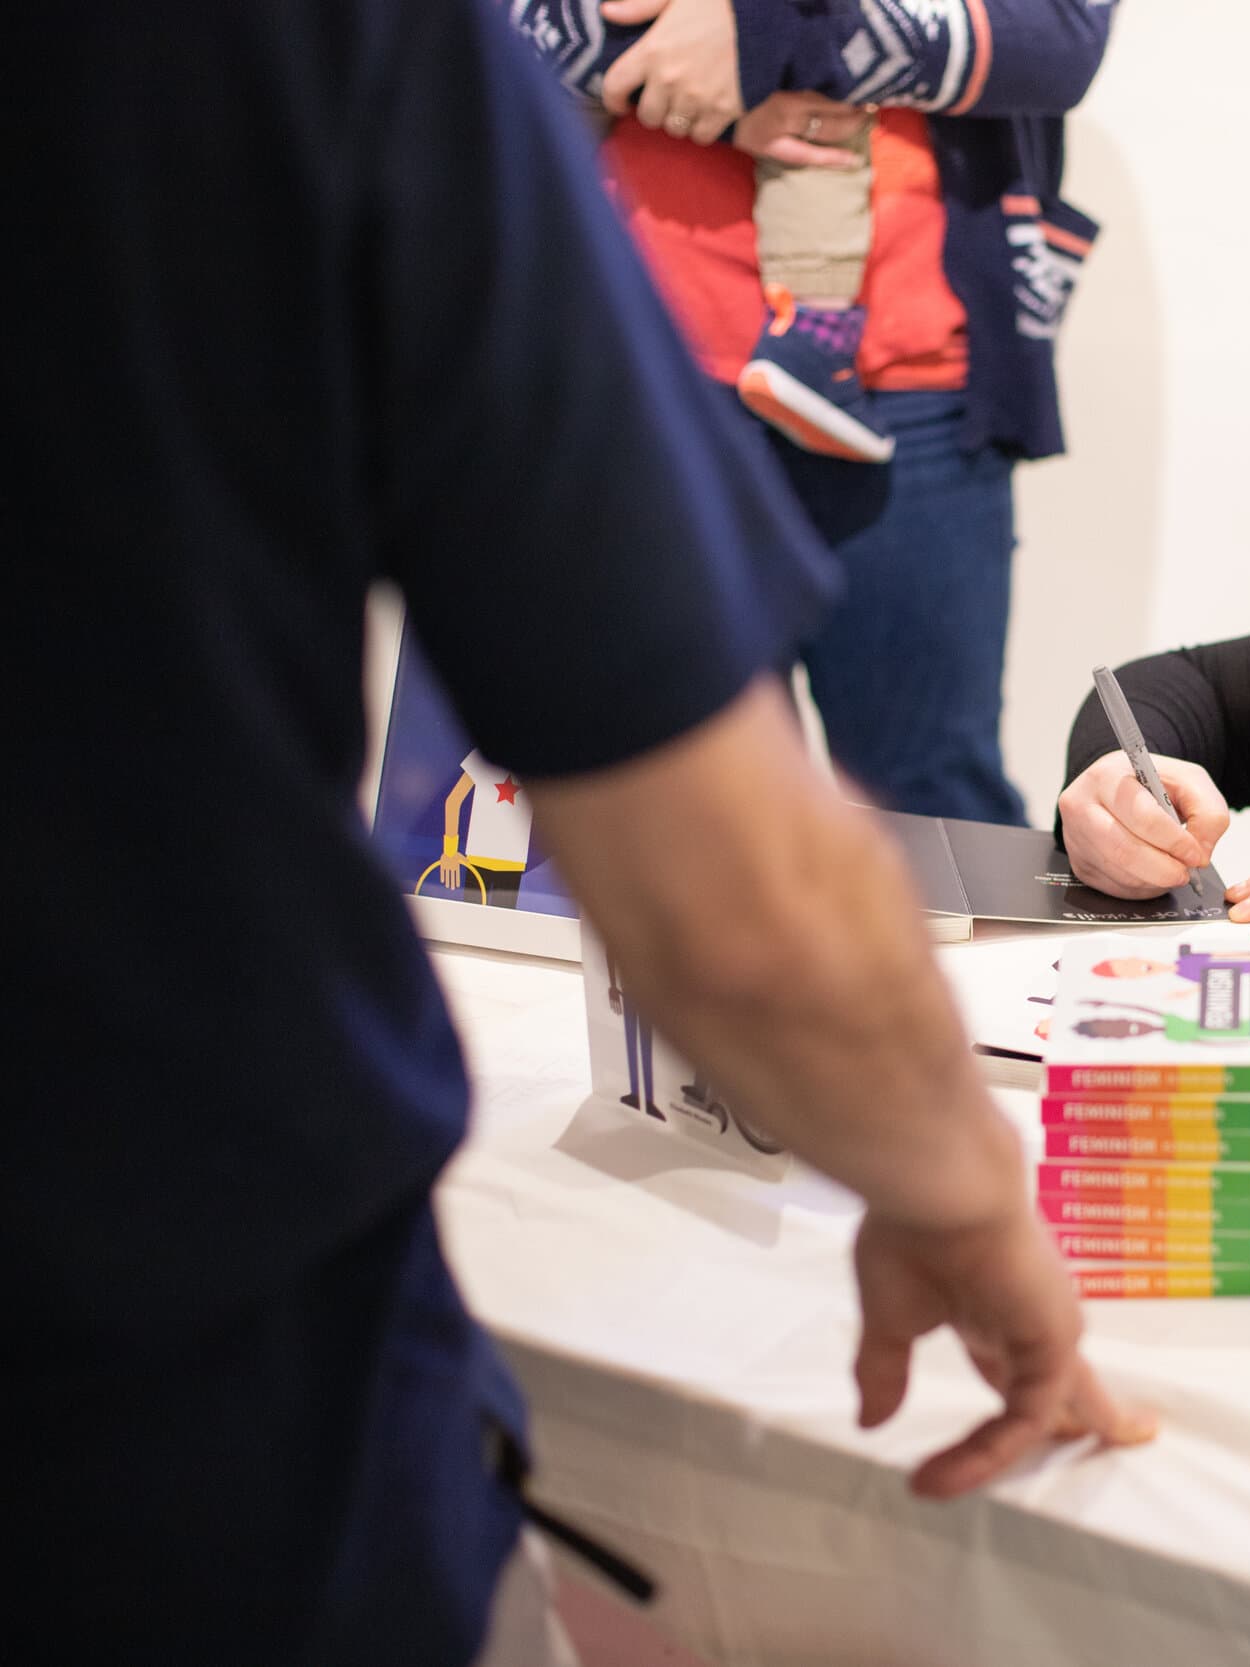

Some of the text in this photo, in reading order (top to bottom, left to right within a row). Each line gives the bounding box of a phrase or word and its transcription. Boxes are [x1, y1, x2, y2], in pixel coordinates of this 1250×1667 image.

[1071, 1069, 1161, 1087] FEMINISM
[1063, 1102, 1152, 1121] FEMINISM
[1068, 1136, 1158, 1154] FEMINISM
[1060, 1168, 1149, 1187] FEMINISM
[1061, 1201, 1149, 1220] FEMINISM
